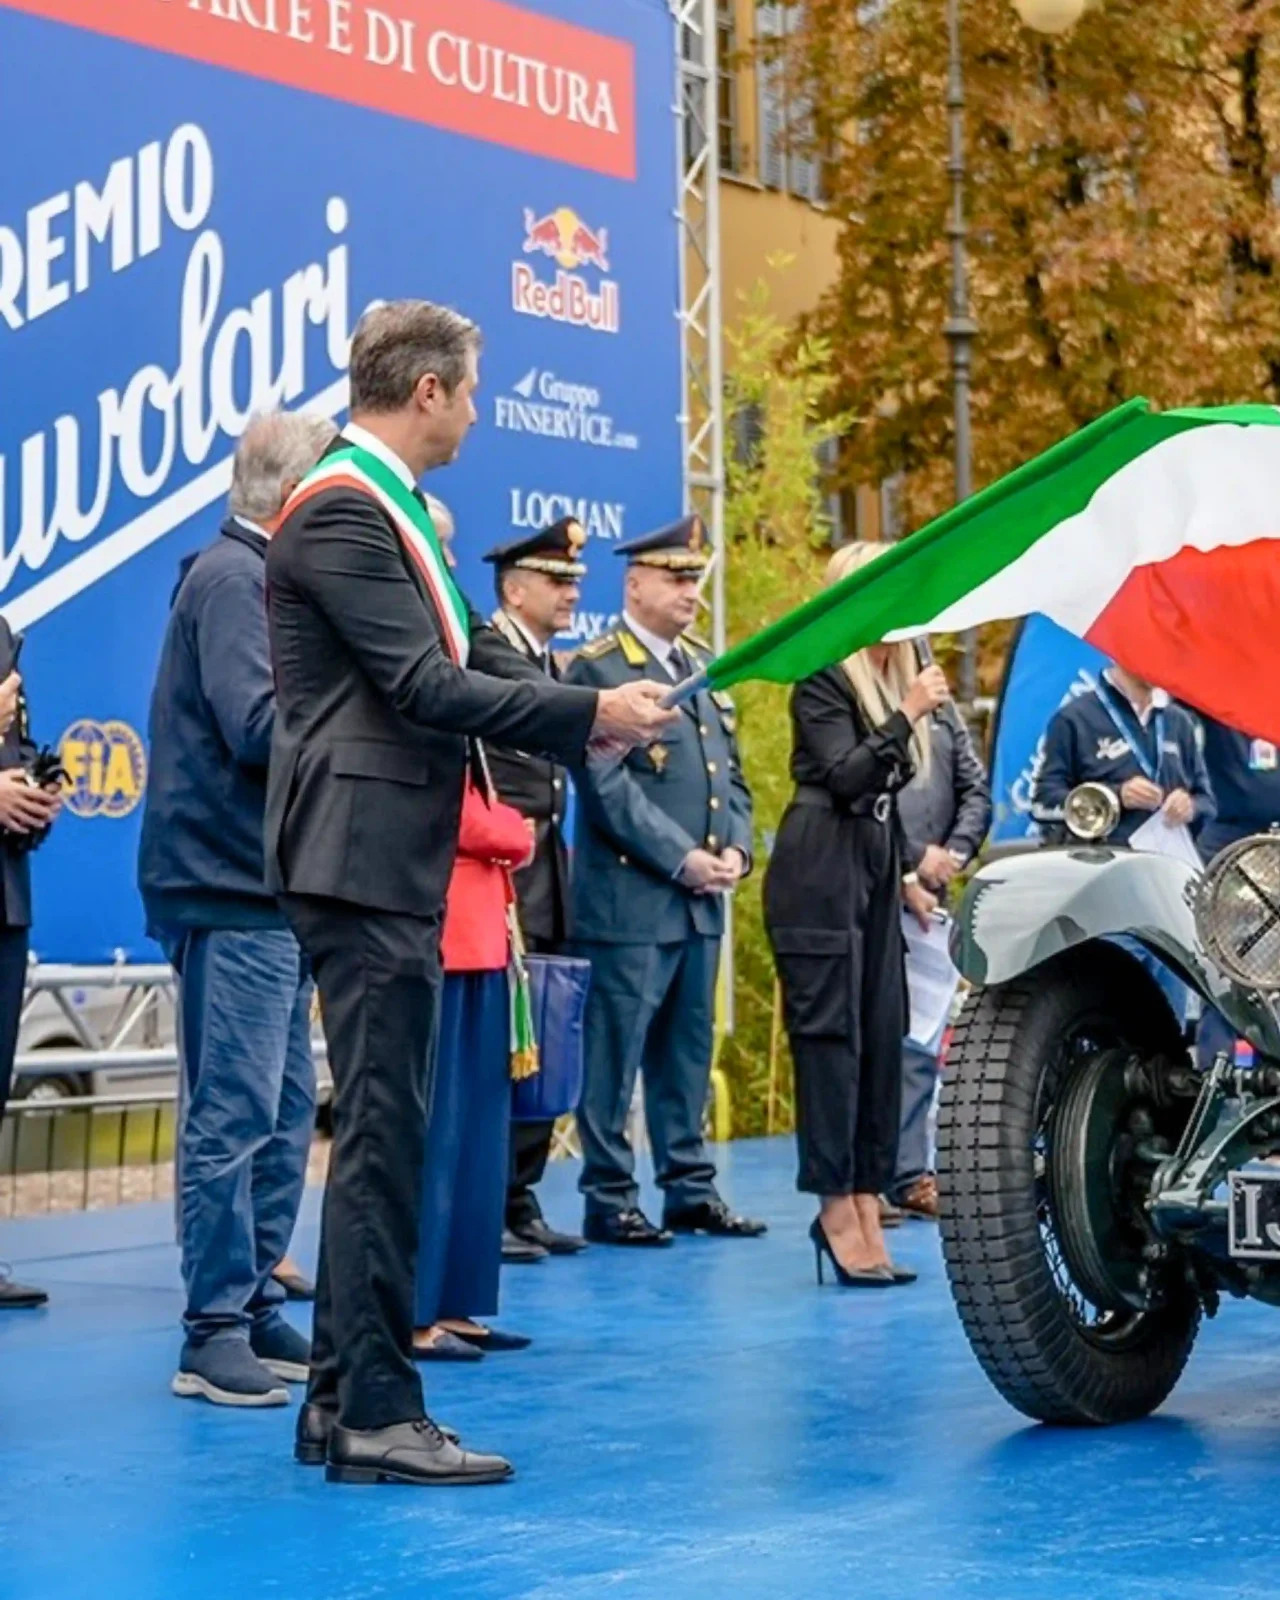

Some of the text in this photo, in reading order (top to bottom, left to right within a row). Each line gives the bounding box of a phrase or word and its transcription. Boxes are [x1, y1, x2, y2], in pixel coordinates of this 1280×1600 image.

[325, 0, 353, 54] E
[364, 8, 416, 73] DI
[427, 30, 620, 134] CULTURA
[538, 371, 600, 412] Gruppo
[510, 488, 624, 540] LOCMAN
[62, 741, 137, 797] FIA
